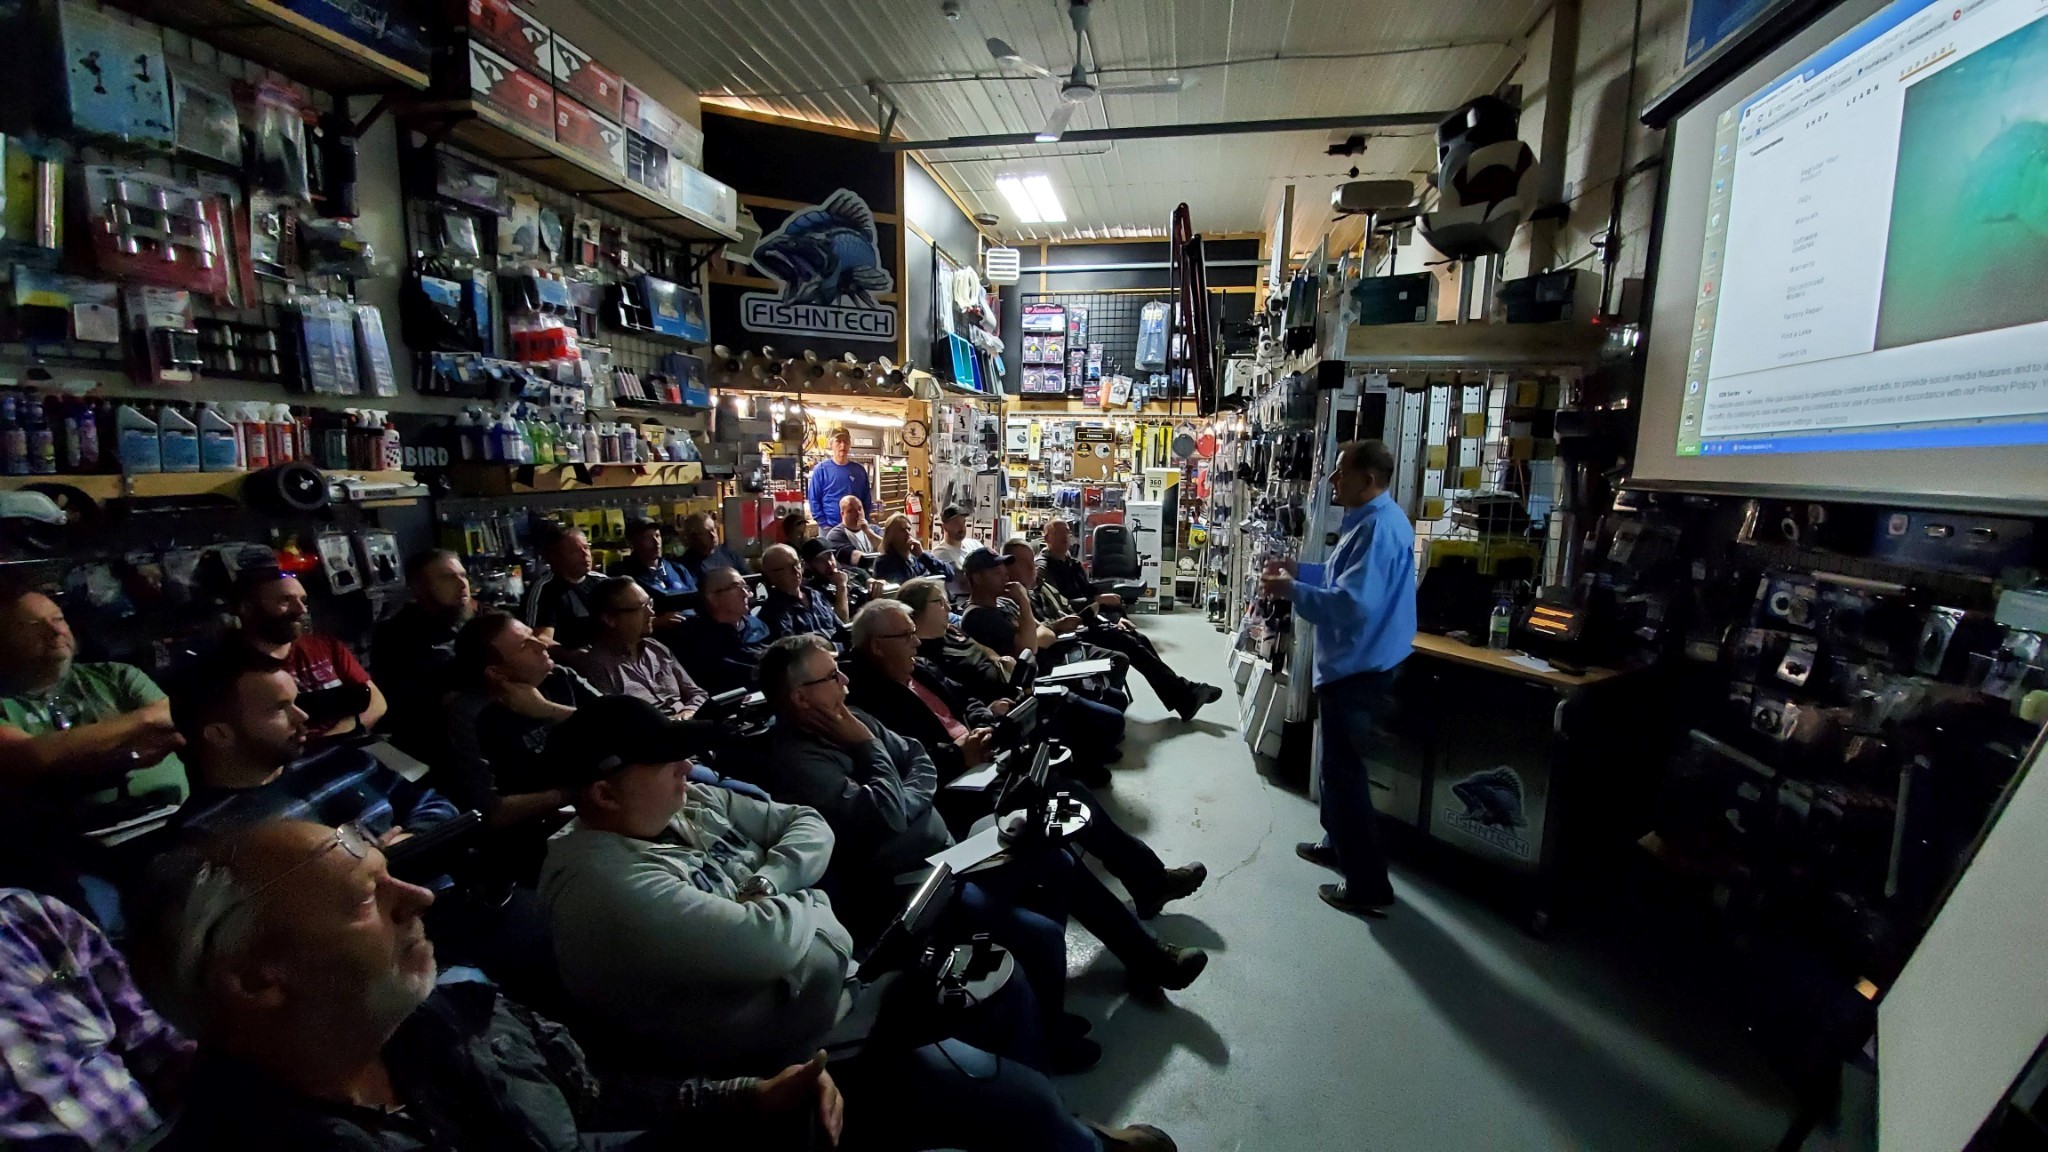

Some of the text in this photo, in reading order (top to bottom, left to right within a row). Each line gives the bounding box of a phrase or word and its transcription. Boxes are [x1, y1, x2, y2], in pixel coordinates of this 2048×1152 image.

[1900, 42, 1954, 77] SUPPORT
[1846, 84, 1880, 107] LEARN
[1805, 112, 1829, 130] SHOP
[752, 303, 889, 333] FISHNTECH
[1902, 377, 1928, 389] provide
[1929, 375, 1950, 385] social
[1952, 372, 1977, 382] media
[1978, 367, 2012, 379] features
[2013, 364, 2032, 374] and
[2032, 362, 2041, 373] to
[1904, 390, 1945, 402] accordance
[1947, 387, 1962, 397] with
[1963, 385, 1976, 395] our
[1977, 381, 2009, 394] Privacy
[400, 446, 449, 467] BIRD
[1447, 812, 1526, 854] FISHNTECH
